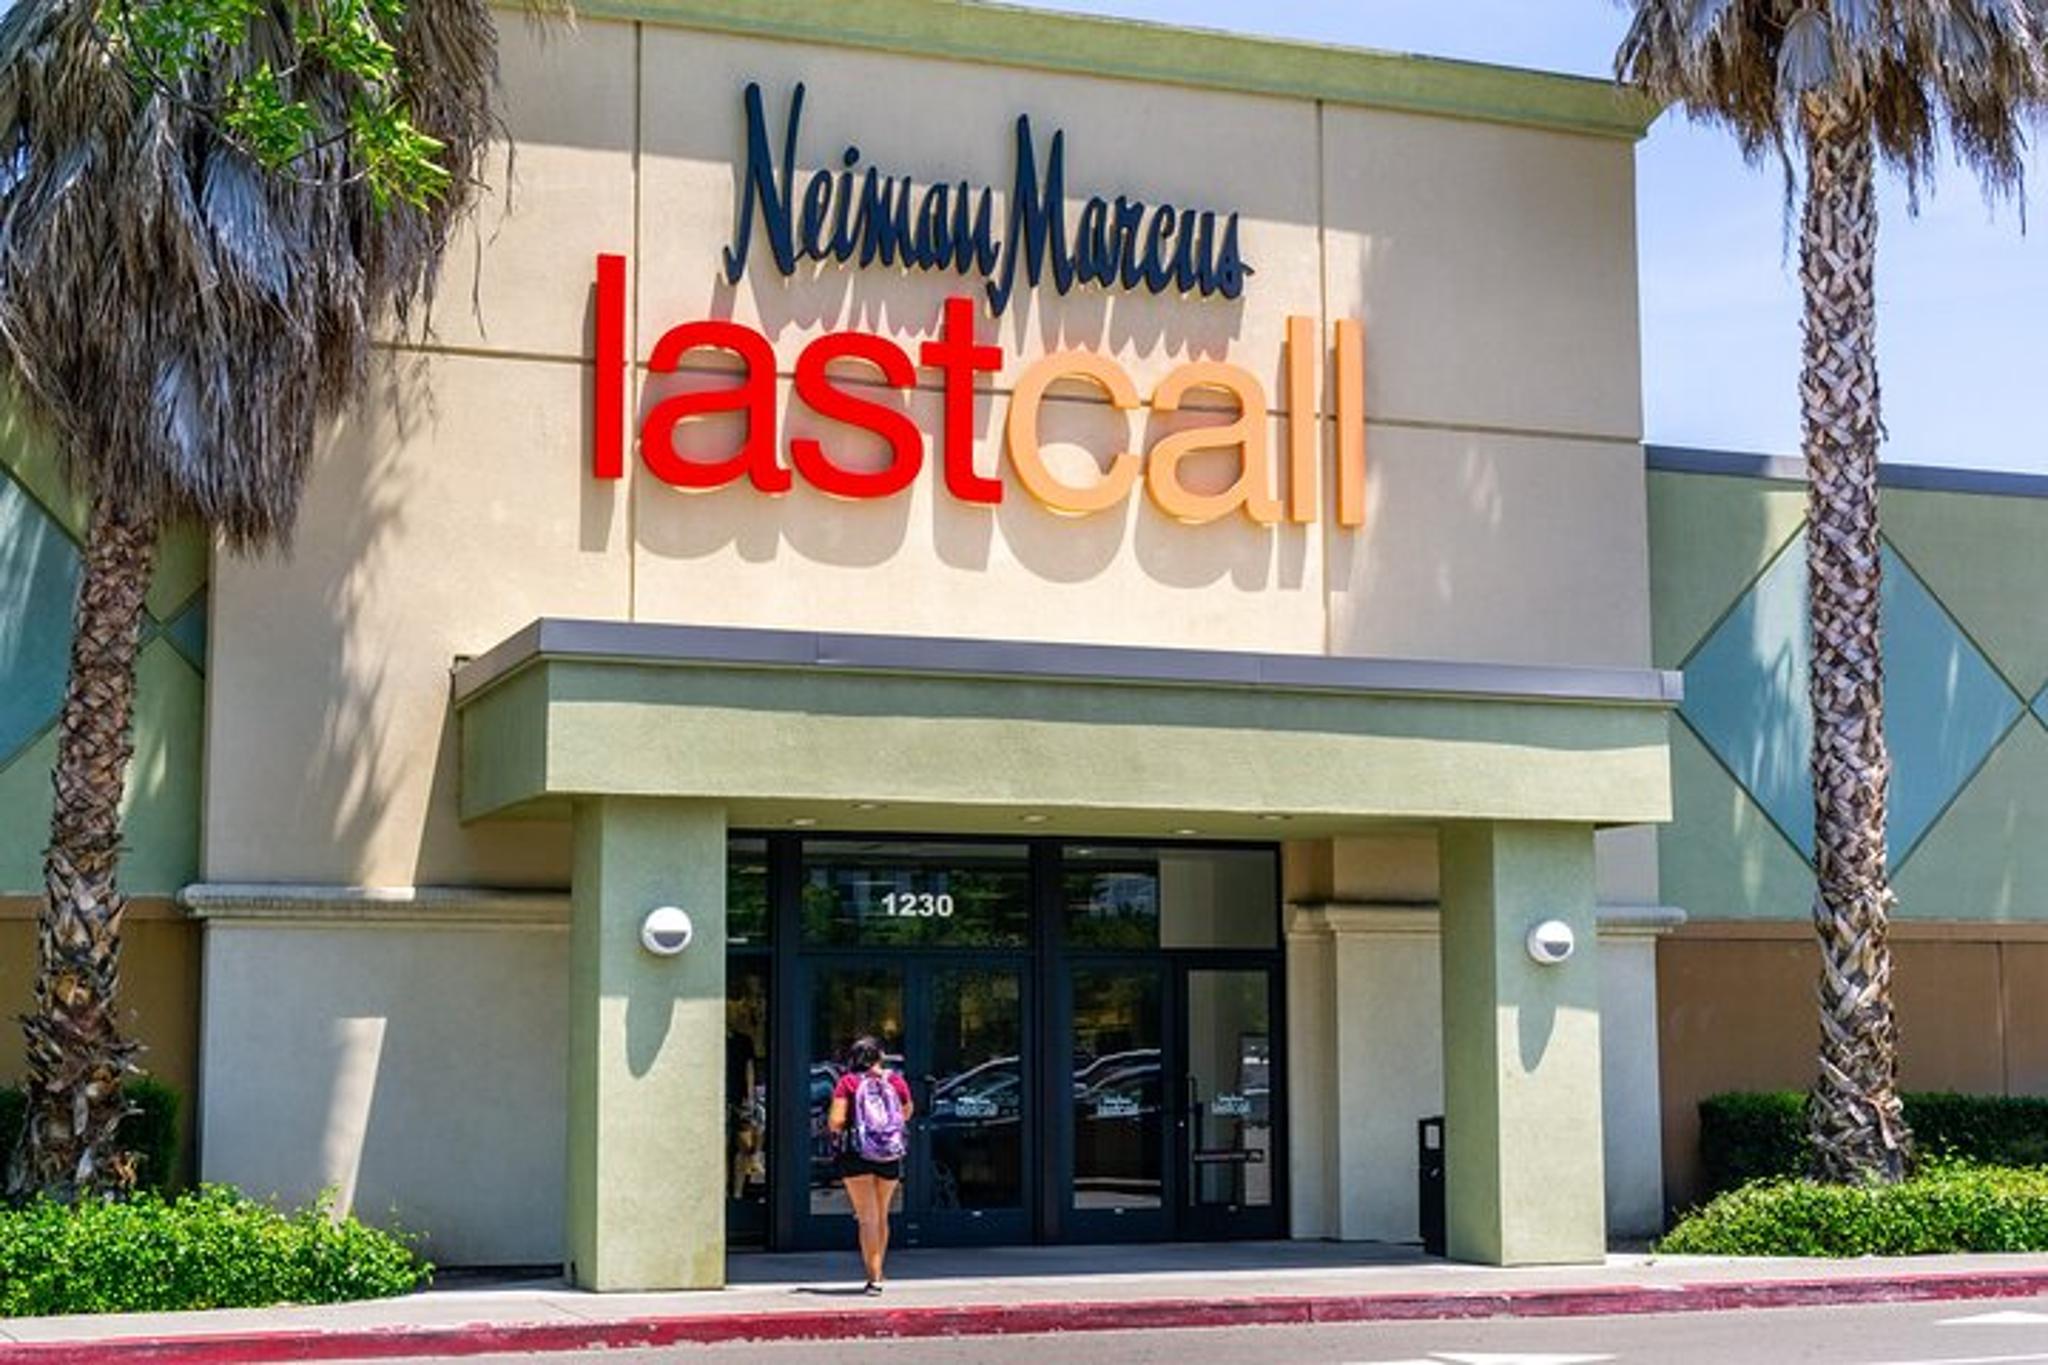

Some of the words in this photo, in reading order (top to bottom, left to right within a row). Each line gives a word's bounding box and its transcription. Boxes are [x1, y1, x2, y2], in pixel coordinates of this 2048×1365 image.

[723, 82, 1001, 286] Neiman
[984, 112, 1254, 318] Marcus
[881, 892, 954, 917] 1230
